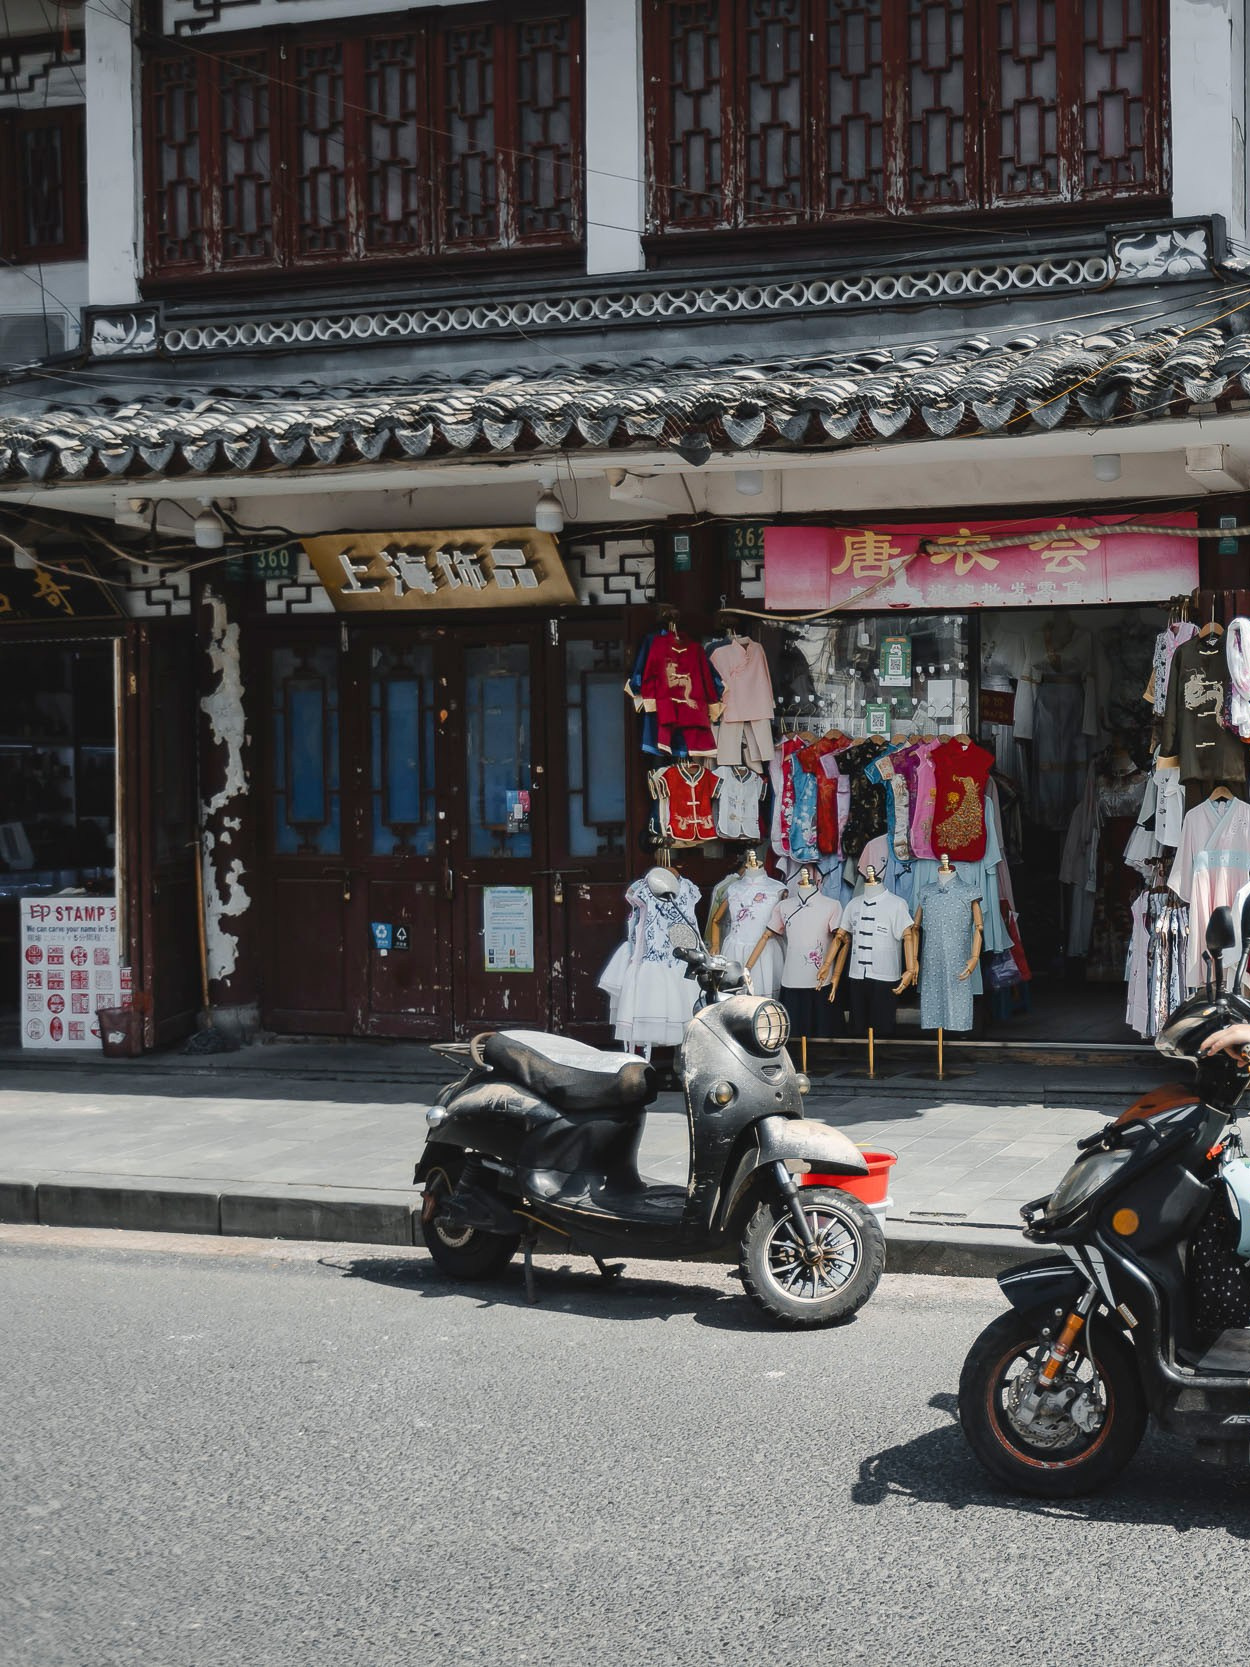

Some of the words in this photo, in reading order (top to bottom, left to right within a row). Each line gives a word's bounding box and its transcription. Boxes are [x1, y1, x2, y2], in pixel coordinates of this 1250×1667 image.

[735, 528, 764, 547] 362
[257, 550, 289, 568] 360
[338, 548, 539, 597] 上海饰品
[849, 580, 1083, 602] 唐装旗袍批发零售
[56, 905, 106, 922] STAMP
[26, 925, 36, 933] We
[66, 926, 81, 934] your
